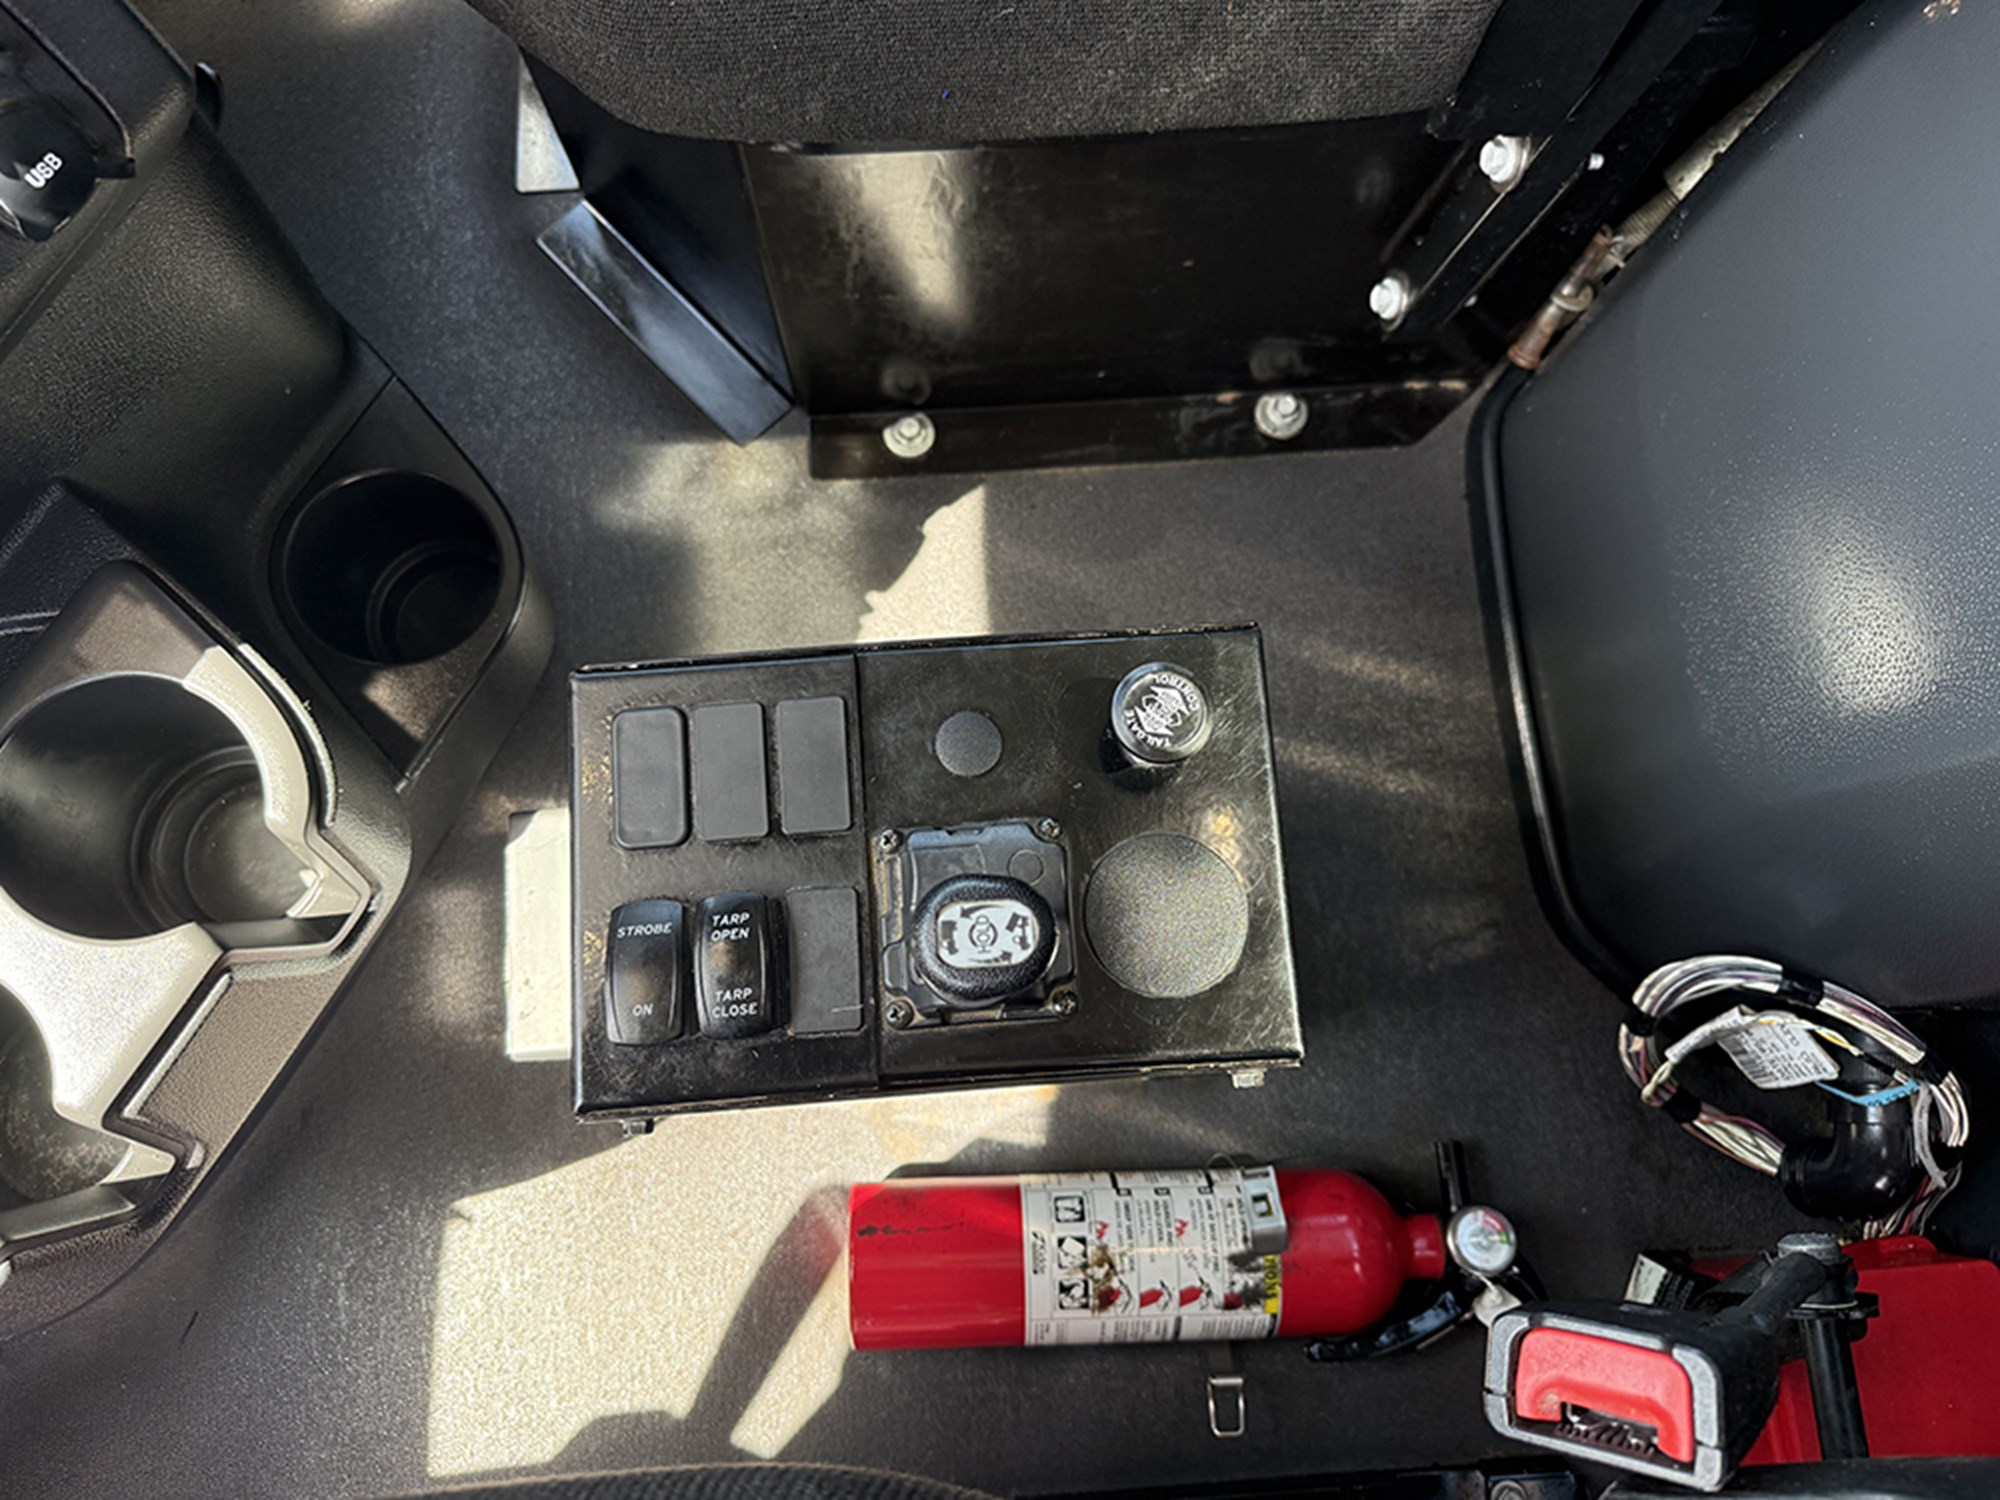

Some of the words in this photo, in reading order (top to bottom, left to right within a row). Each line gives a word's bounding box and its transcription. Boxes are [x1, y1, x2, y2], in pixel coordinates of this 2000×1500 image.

[24, 152, 62, 188] USB
[1123, 709, 1172, 747] TAILGATE
[711, 912, 751, 927] TARP
[616, 922, 673, 939] STROBE
[710, 927, 750, 942] OPEN
[715, 987, 753, 1002] TARP
[632, 1003, 653, 1016] ON
[712, 1003, 758, 1018] CLOSE
